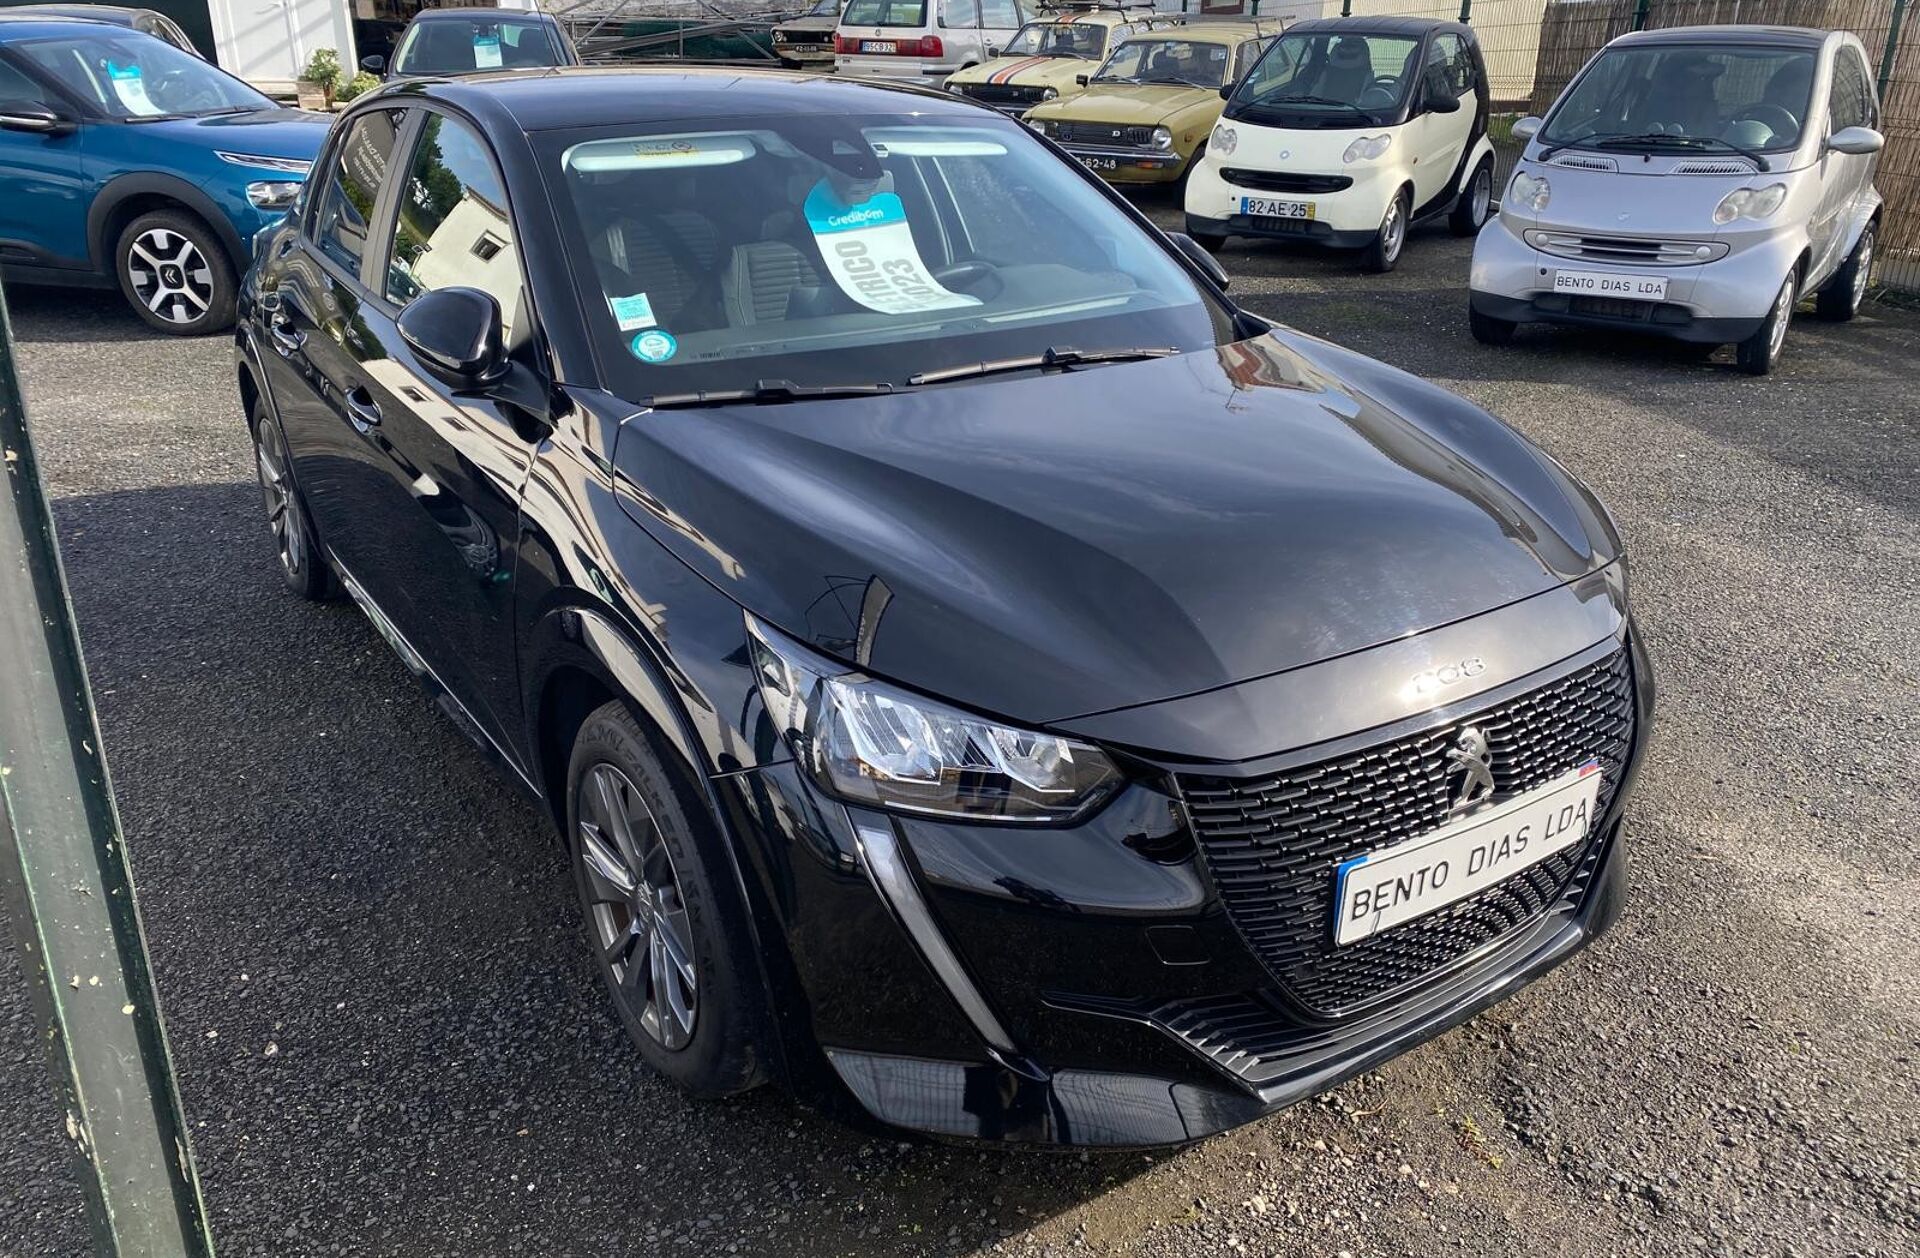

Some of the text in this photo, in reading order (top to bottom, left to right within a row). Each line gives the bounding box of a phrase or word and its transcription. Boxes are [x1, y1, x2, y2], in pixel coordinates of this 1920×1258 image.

[835, 240, 901, 304] TRICO
[882, 258, 938, 299] 023
[1556, 276, 1663, 294] BENTO DIAS LDA
[1351, 797, 1588, 921] BENTO DIAS LDA
